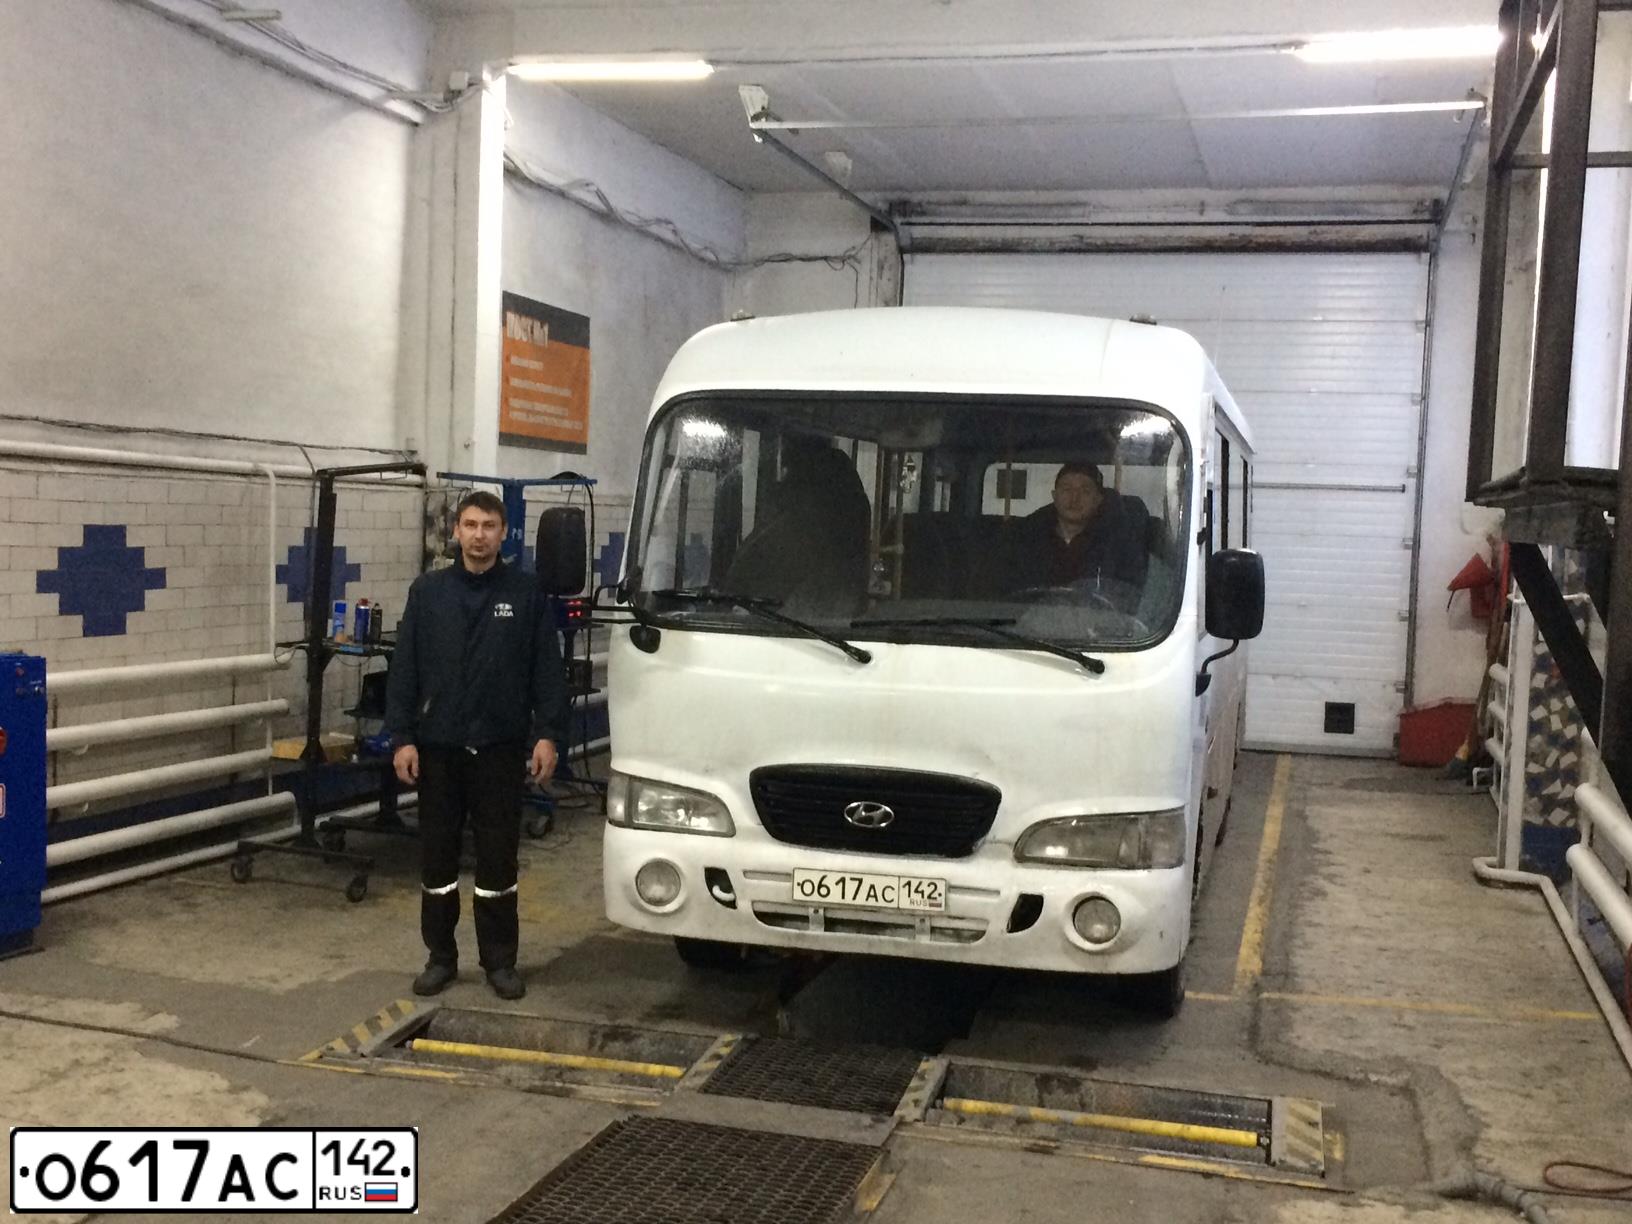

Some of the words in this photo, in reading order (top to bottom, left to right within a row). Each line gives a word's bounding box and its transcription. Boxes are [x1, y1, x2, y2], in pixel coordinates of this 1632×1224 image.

[800, 874, 896, 904] O617AC
[902, 880, 938, 900] 142
[909, 898, 929, 907] RUS
